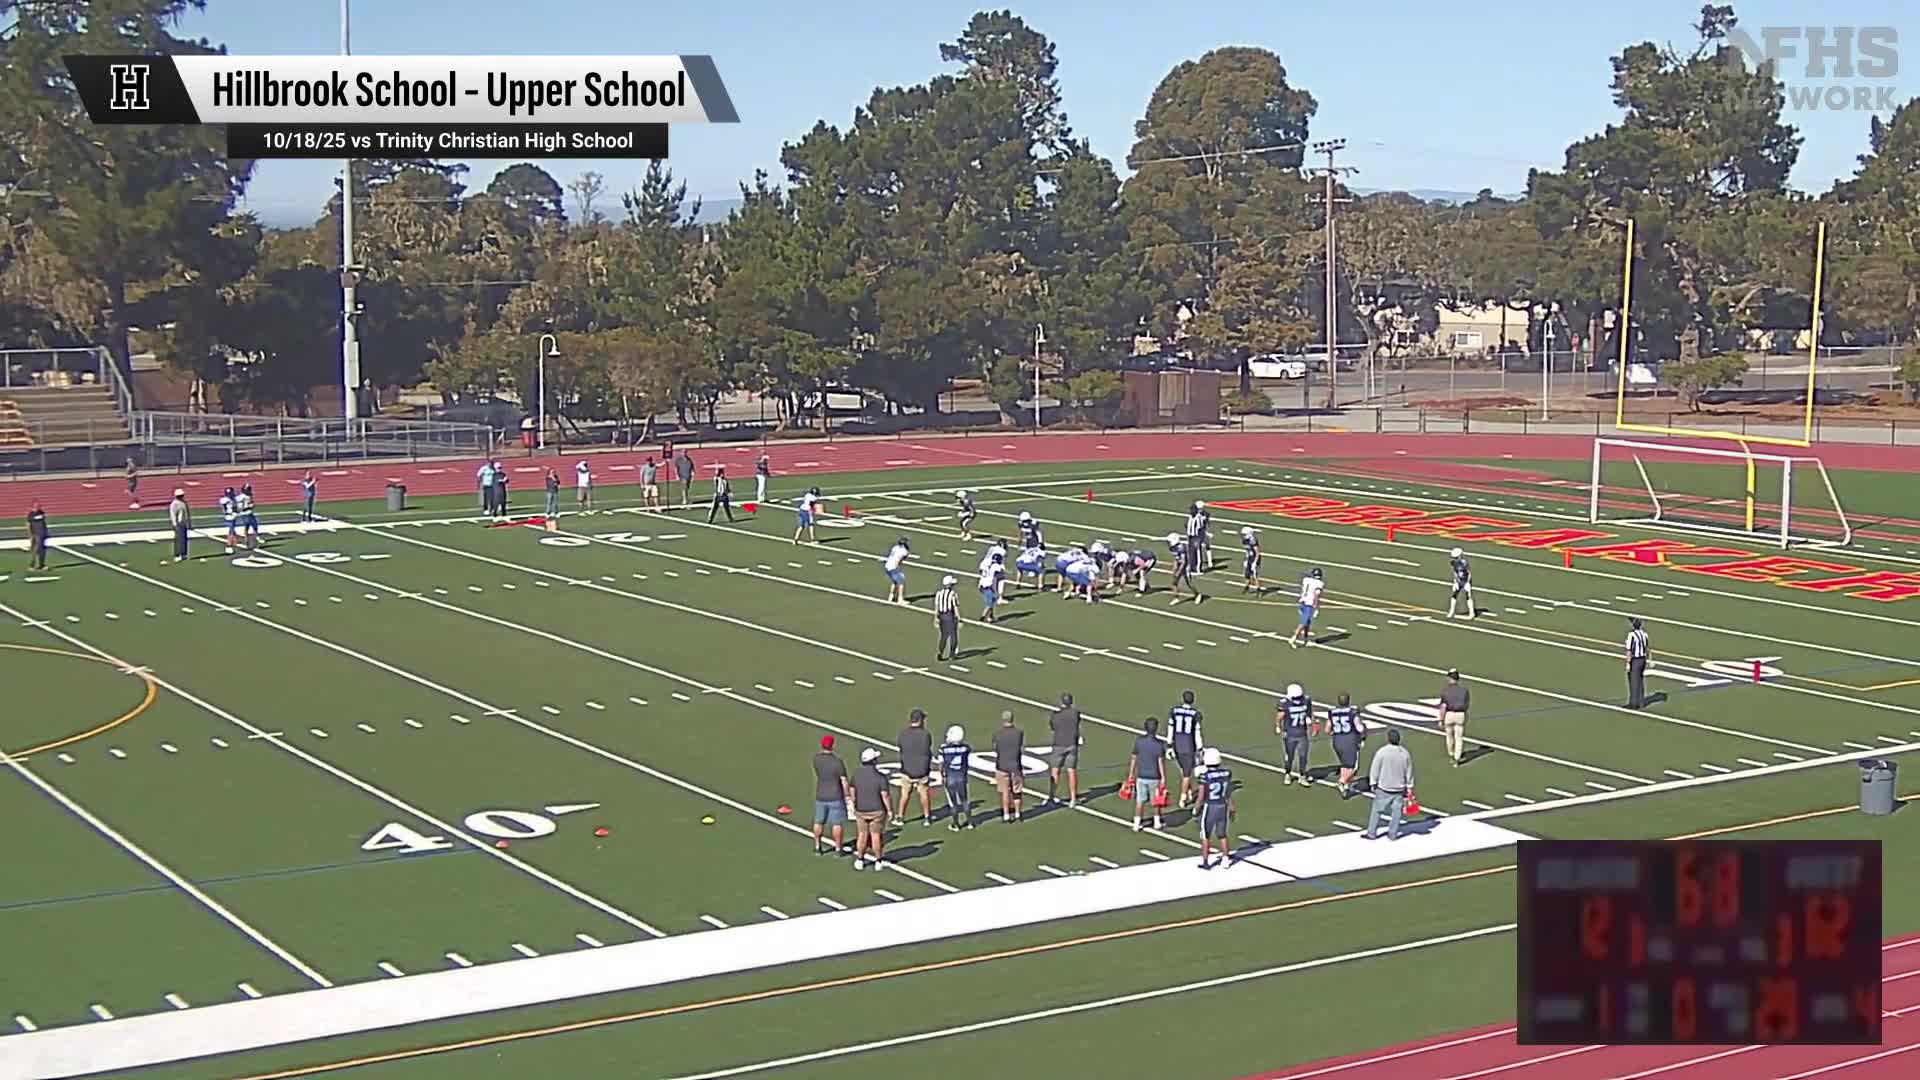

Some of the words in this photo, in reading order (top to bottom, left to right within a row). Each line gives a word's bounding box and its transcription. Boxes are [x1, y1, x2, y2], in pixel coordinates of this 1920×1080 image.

[1174, 714, 1193, 735] 11
[1332, 714, 1351, 734] 55
[1208, 781, 1228, 801] 21
[361, 810, 557, 854] 40
